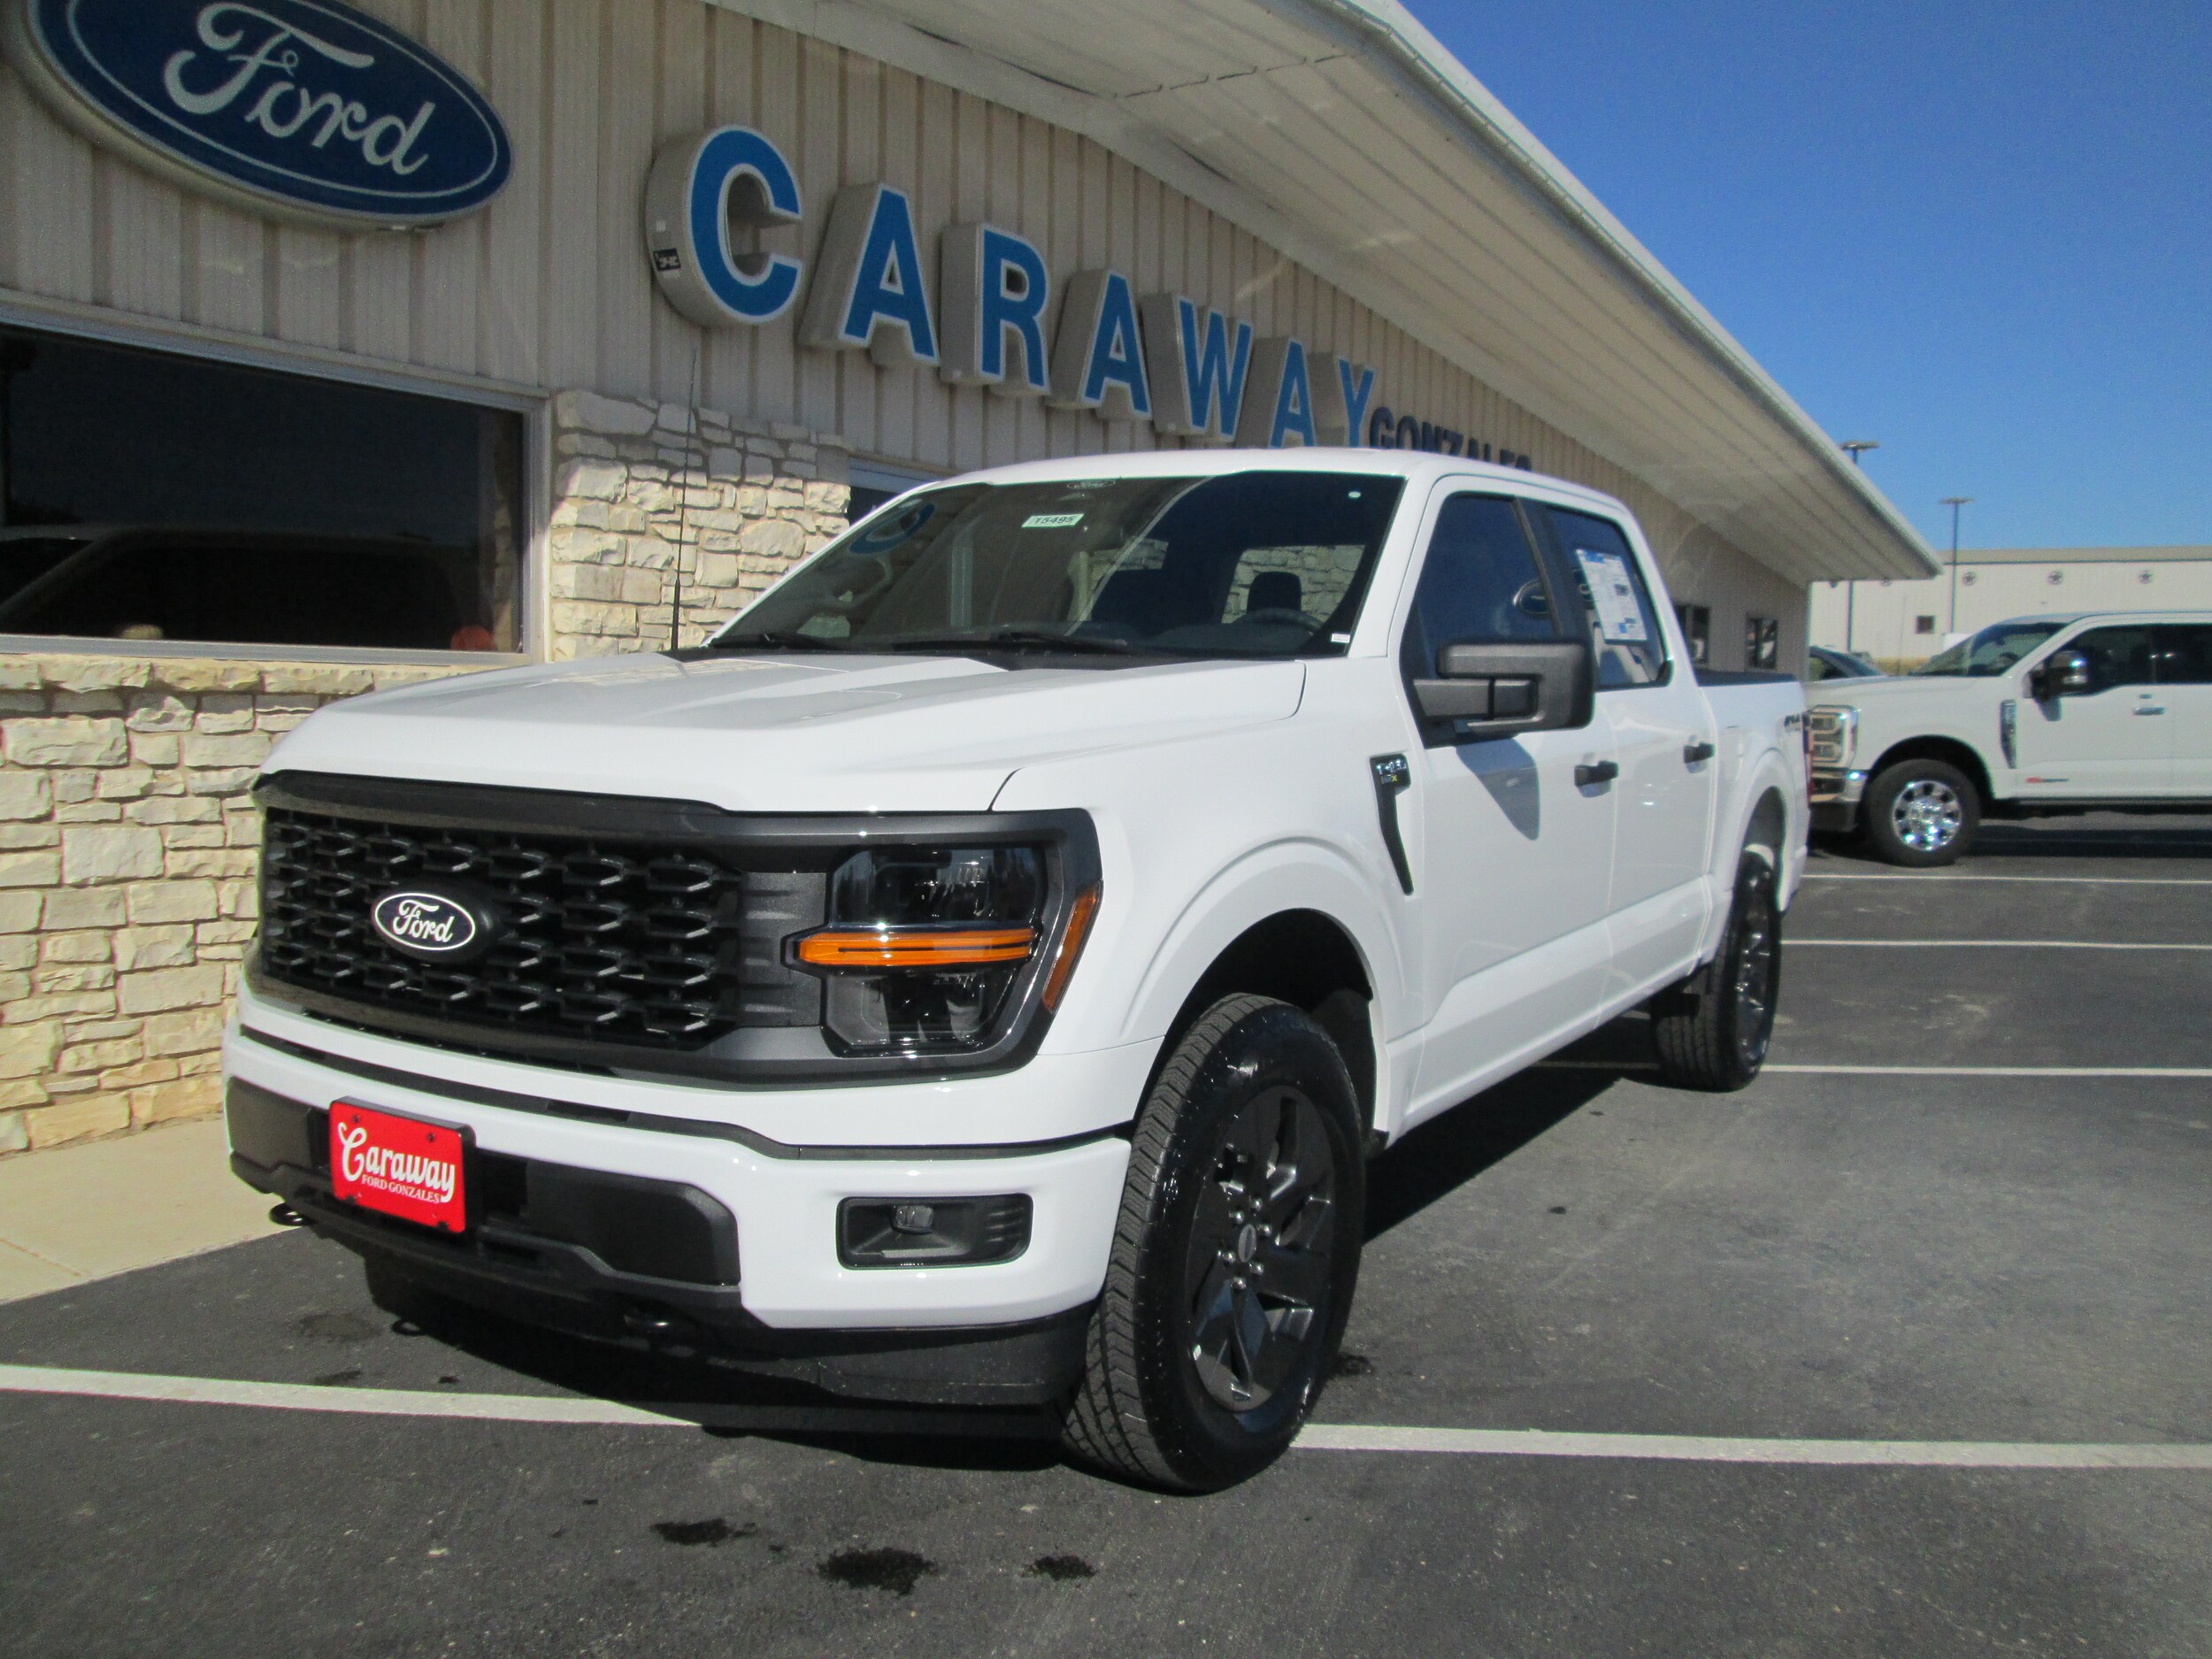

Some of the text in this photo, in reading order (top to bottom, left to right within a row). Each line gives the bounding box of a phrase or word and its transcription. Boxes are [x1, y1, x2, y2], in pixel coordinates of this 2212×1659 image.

[163, 2, 436, 176] Ford
[689, 123, 1375, 449] CARAWAY
[392, 899, 456, 943] Ford
[337, 1121, 457, 1204] Caraway
[361, 1174, 441, 1204] FORD GONZALES
